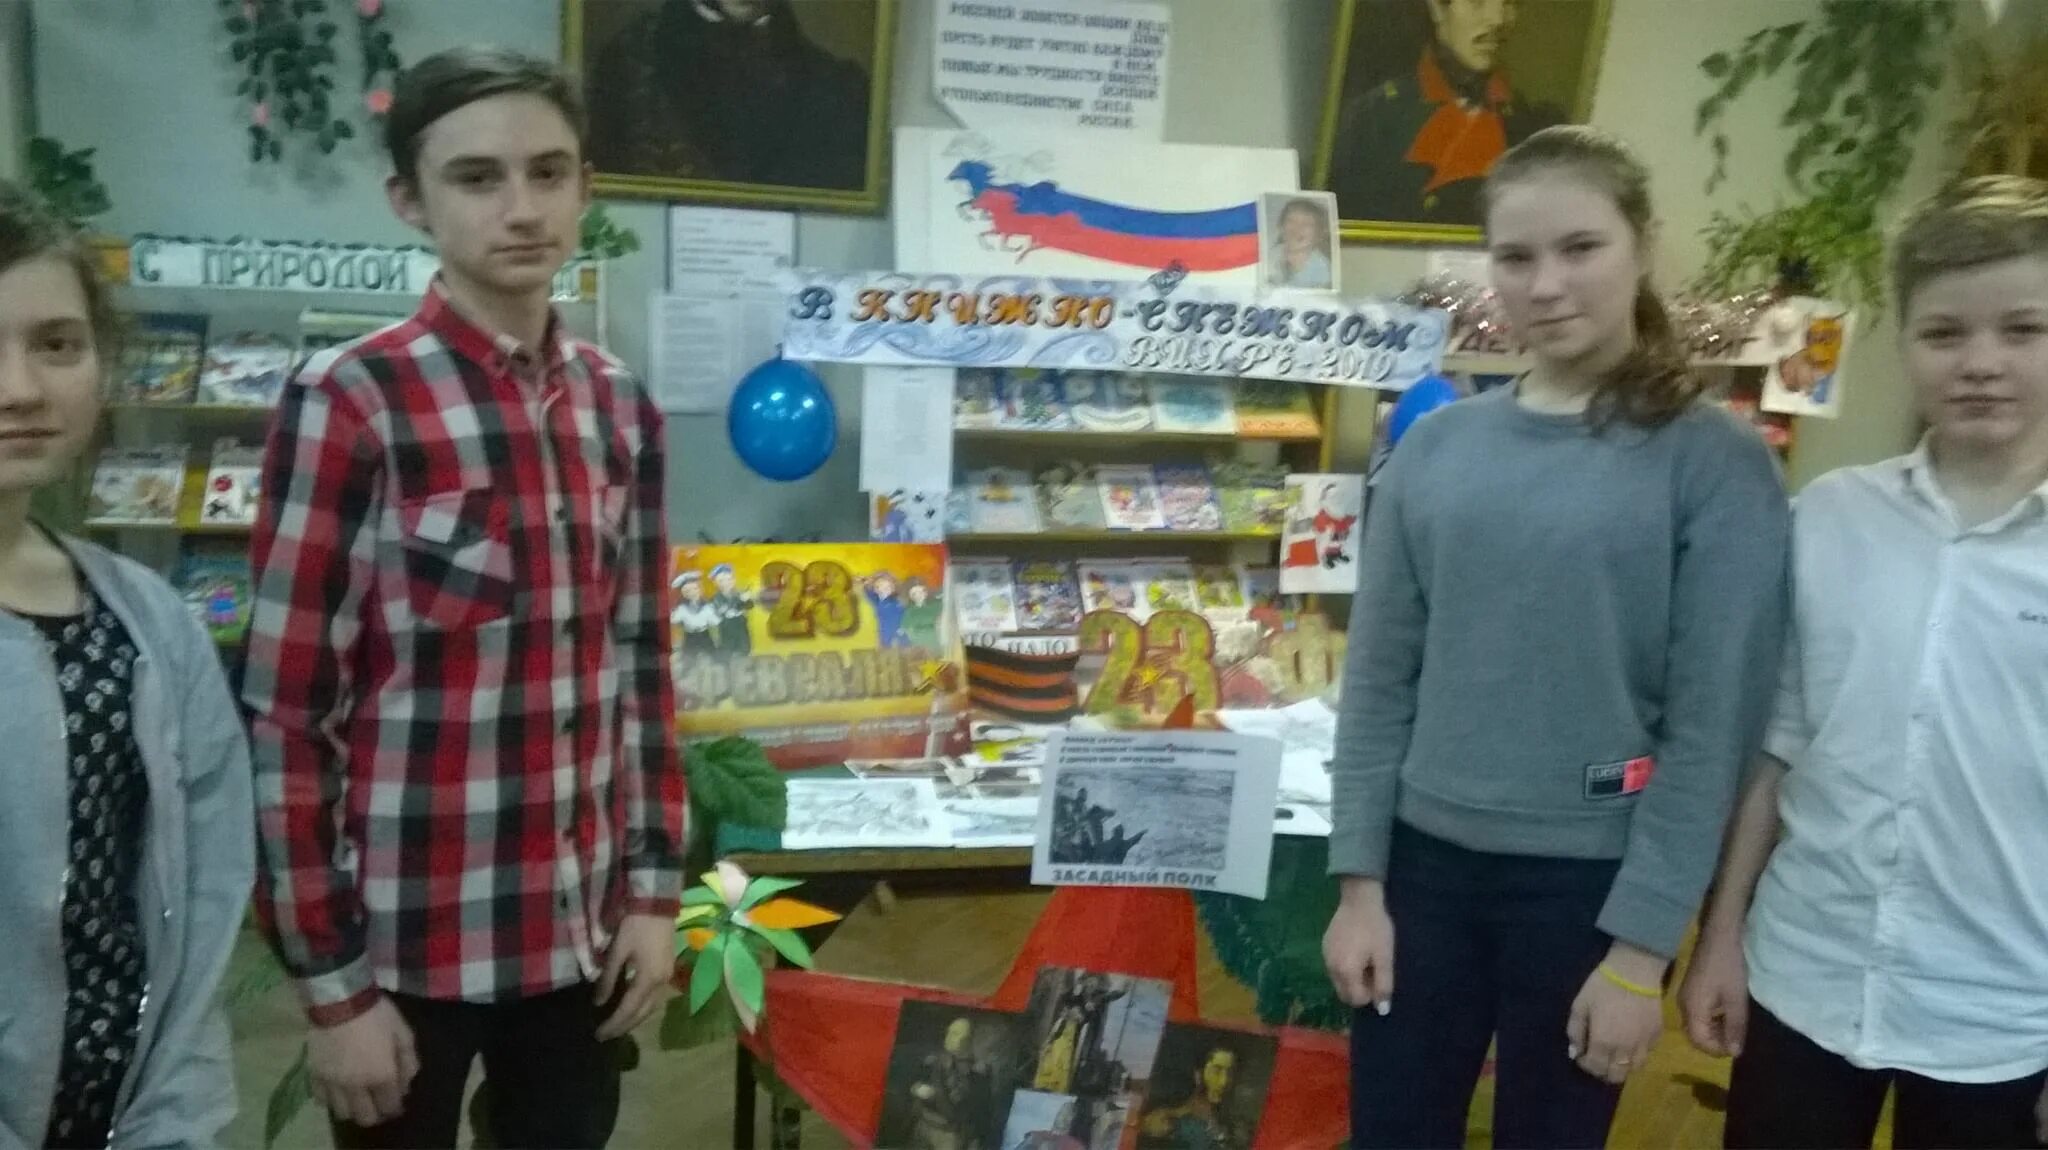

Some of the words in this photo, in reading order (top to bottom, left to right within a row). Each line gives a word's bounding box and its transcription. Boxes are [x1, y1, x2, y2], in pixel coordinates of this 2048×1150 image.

[791, 285, 833, 320] В
[760, 560, 860, 639] 23
[1078, 609, 1222, 725] 23
[1052, 868, 1159, 886] ЗАСАДНЫЙ
[1163, 871, 1217, 888] ПОЛК
